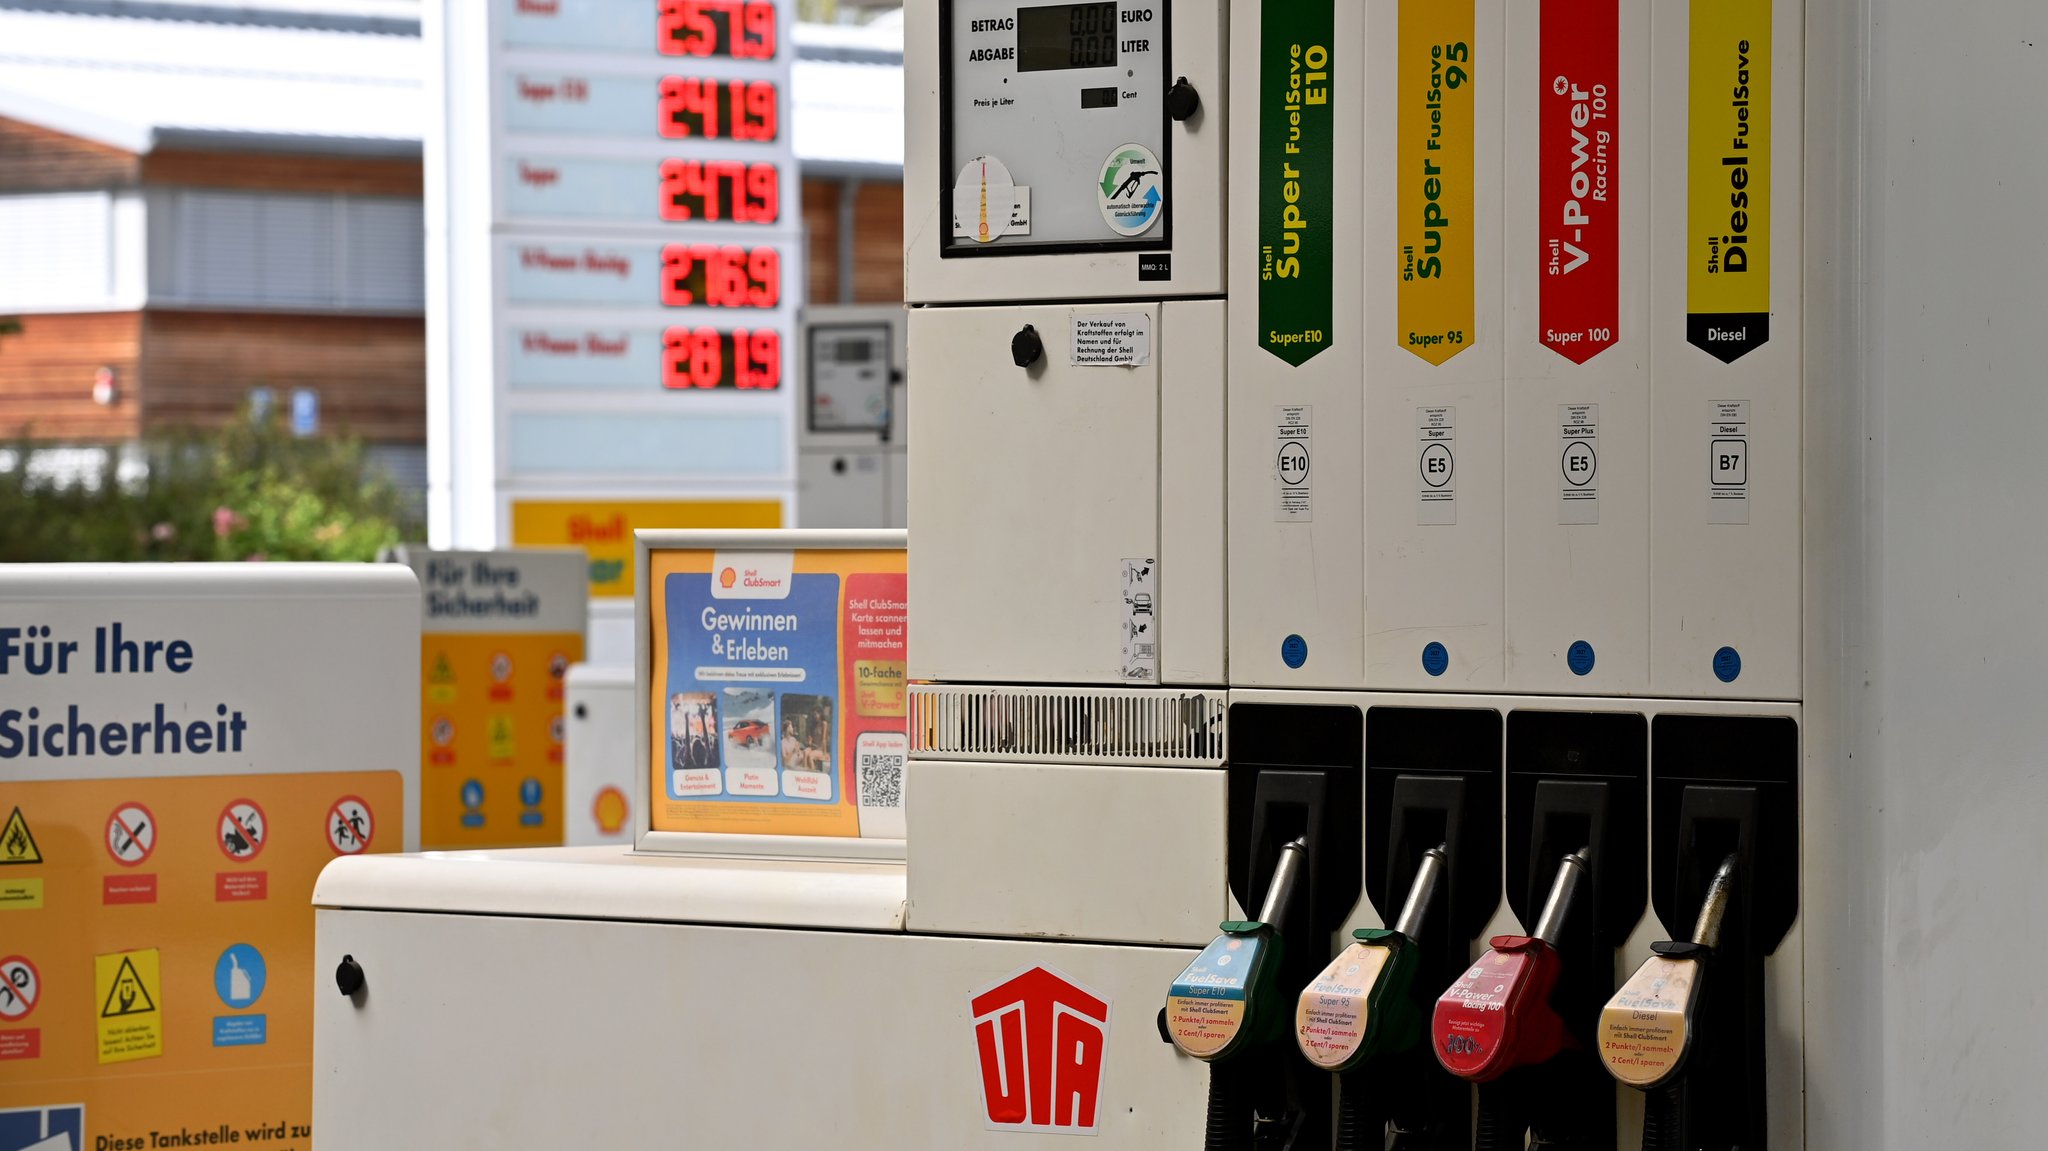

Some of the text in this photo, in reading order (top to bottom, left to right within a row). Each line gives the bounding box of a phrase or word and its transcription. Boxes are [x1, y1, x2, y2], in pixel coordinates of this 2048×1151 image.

[1121, 9, 1153, 23] EURO
[971, 18, 1014, 33] BETRAG
[1121, 40, 1150, 53] LITER
[969, 47, 1015, 62] ABGABE
[1446, 41, 1468, 90] 95
[1305, 45, 1328, 105] E10
[1122, 91, 1137, 99] Cent
[974, 98, 1014, 108] Preis je Liter
[1593, 84, 1610, 201] Racing 100
[1276, 43, 1307, 279] Super FuelSave
[1417, 44, 1448, 279] Super FuelSave
[1722, 39, 1750, 273] Diesel FuelSave
[1563, 83, 1590, 274] V-Power
[1548, 239, 1559, 275] Shell
[1707, 236, 1718, 274] Shell
[1261, 245, 1272, 281] Shell
[1403, 245, 1413, 281] Shell
[1408, 330, 1463, 347] Super 95
[1547, 328, 1610, 345] Super 100
[1707, 327, 1746, 342] Diesel
[1280, 428, 1296, 436] Super
[1563, 428, 1580, 436] Super
[1281, 456, 1306, 471] E10
[1428, 458, 1446, 473] E5
[1570, 456, 1588, 471] E5
[1720, 455, 1739, 470] B7
[425, 560, 520, 587] Für Ihre
[743, 578, 781, 587] ClubSmart
[427, 592, 540, 618] Sicherheit
[849, 599, 907, 609] Shell ClubSmar
[701, 606, 798, 631] Gewinnen
[851, 613, 873, 622] Karte
[858, 624, 902, 635] lassen und
[0, 622, 194, 675] Für Ihre
[712, 633, 788, 661] & Erleben
[857, 638, 903, 648] mitmachen
[858, 666, 902, 678] 10-fache
[0, 703, 247, 759] Sicherheit
[1184, 973, 1238, 985] FuelSave
[1454, 981, 1473, 989] Shell
[1189, 985, 1226, 996] Super E10
[1313, 982, 1361, 995] FuelSave
[1450, 988, 1494, 1000] V-Power
[1319, 996, 1350, 1007] Super 95
[1462, 1000, 1501, 1012] Racing 100
[1617, 997, 1676, 1009] FuelSave
[1206, 1018, 1234, 1026] sammeln
[1632, 1011, 1658, 1021] Diesel
[1203, 1031, 1225, 1039] sparen
[971, 966, 1107, 1127] UTA
[1640, 1059, 1664, 1067] sparen
[96, 1121, 311, 1151] Diese Tankstelle wird zu
